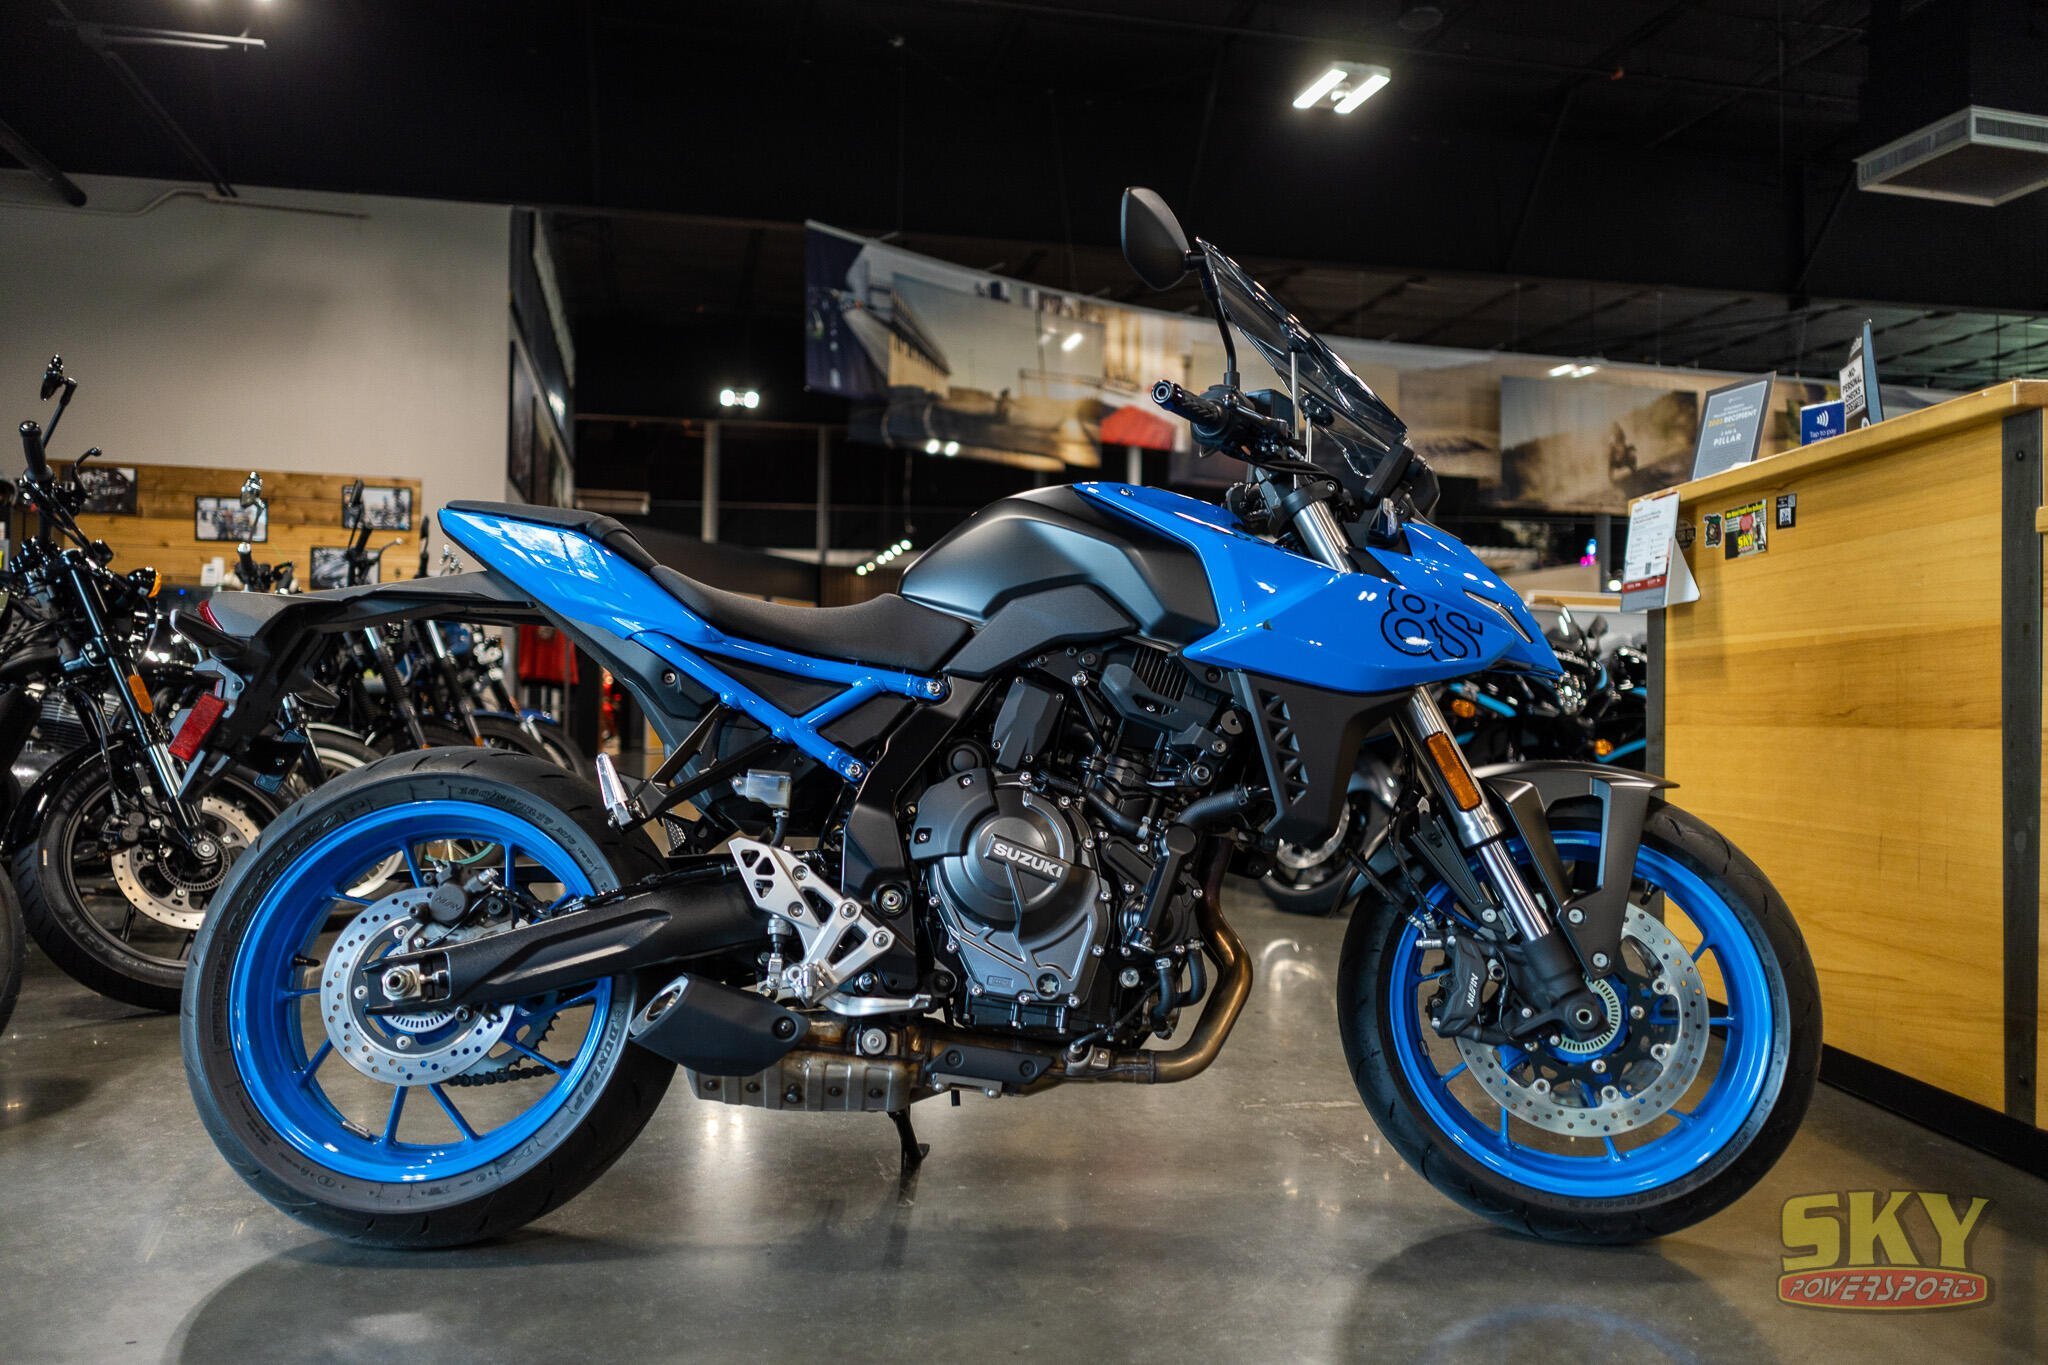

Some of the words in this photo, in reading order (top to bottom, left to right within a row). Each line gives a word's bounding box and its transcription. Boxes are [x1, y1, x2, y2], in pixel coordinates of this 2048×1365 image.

[1713, 433, 1742, 447] PILLAR
[993, 842, 1064, 878] SUZUKI
[574, 1023, 619, 1112] DUNLOP
